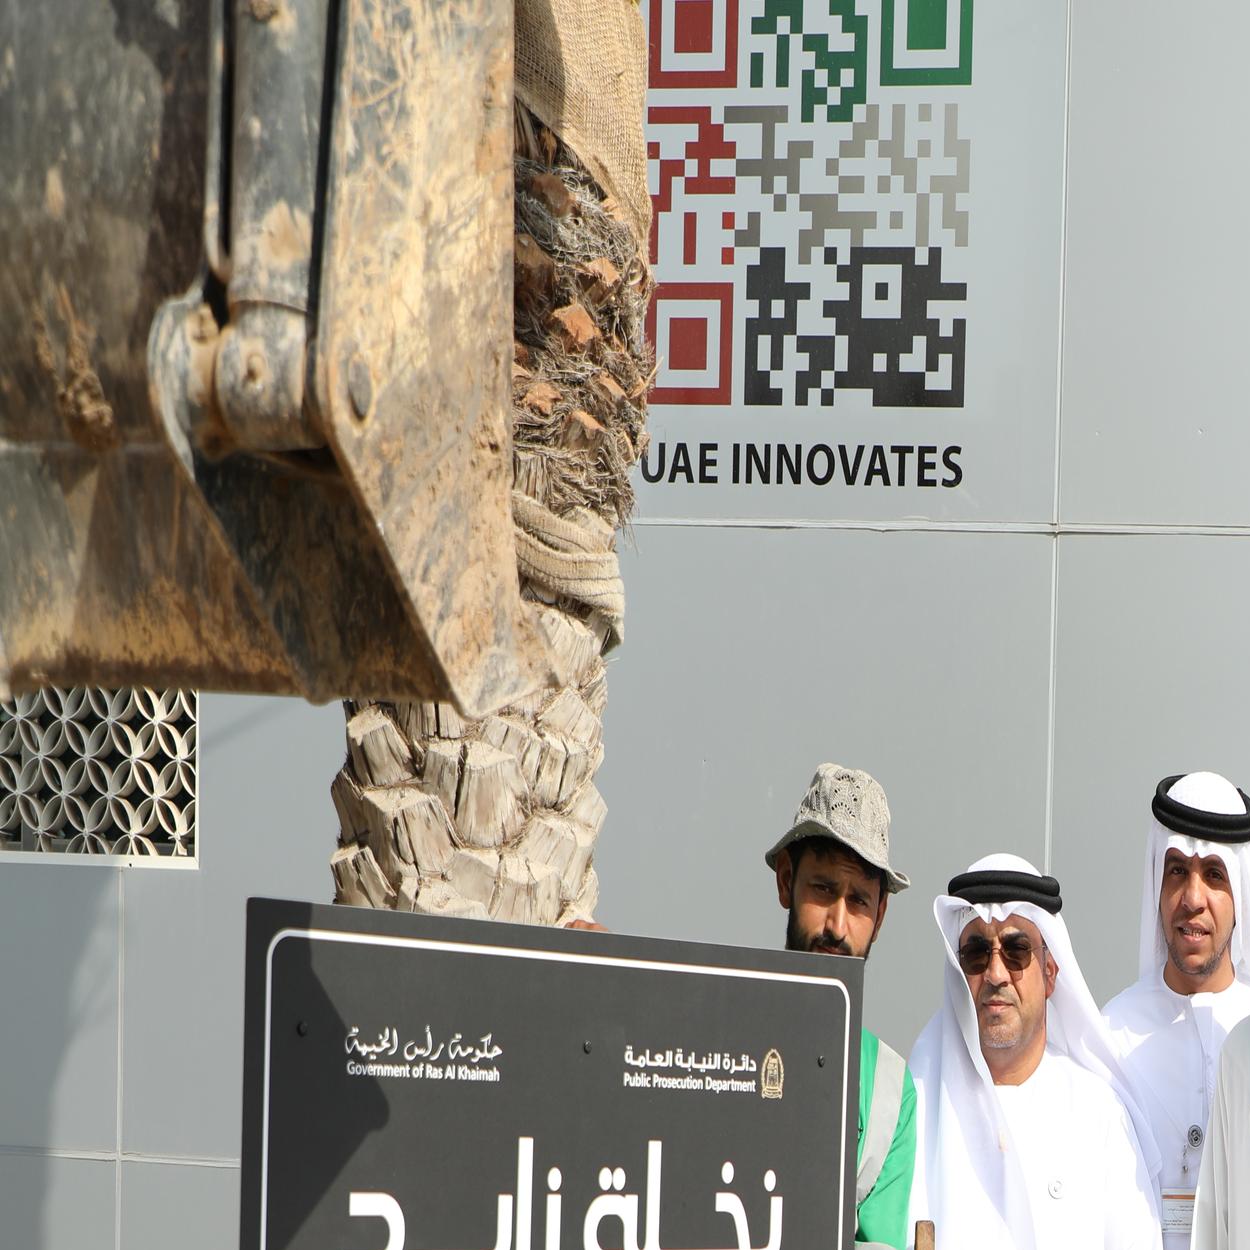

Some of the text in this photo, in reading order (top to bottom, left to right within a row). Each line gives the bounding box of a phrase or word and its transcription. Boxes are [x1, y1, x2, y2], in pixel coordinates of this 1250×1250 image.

[641, 442, 963, 488] UAE INNOVATES
[345, 1024, 503, 1063] حكومة رأس الخيمة
[347, 1061, 500, 1082] Government of Ras Al Khaimah
[624, 1045, 757, 1074] دائرة النيابة العامة
[623, 1072, 756, 1094] Public Prosecution Department
